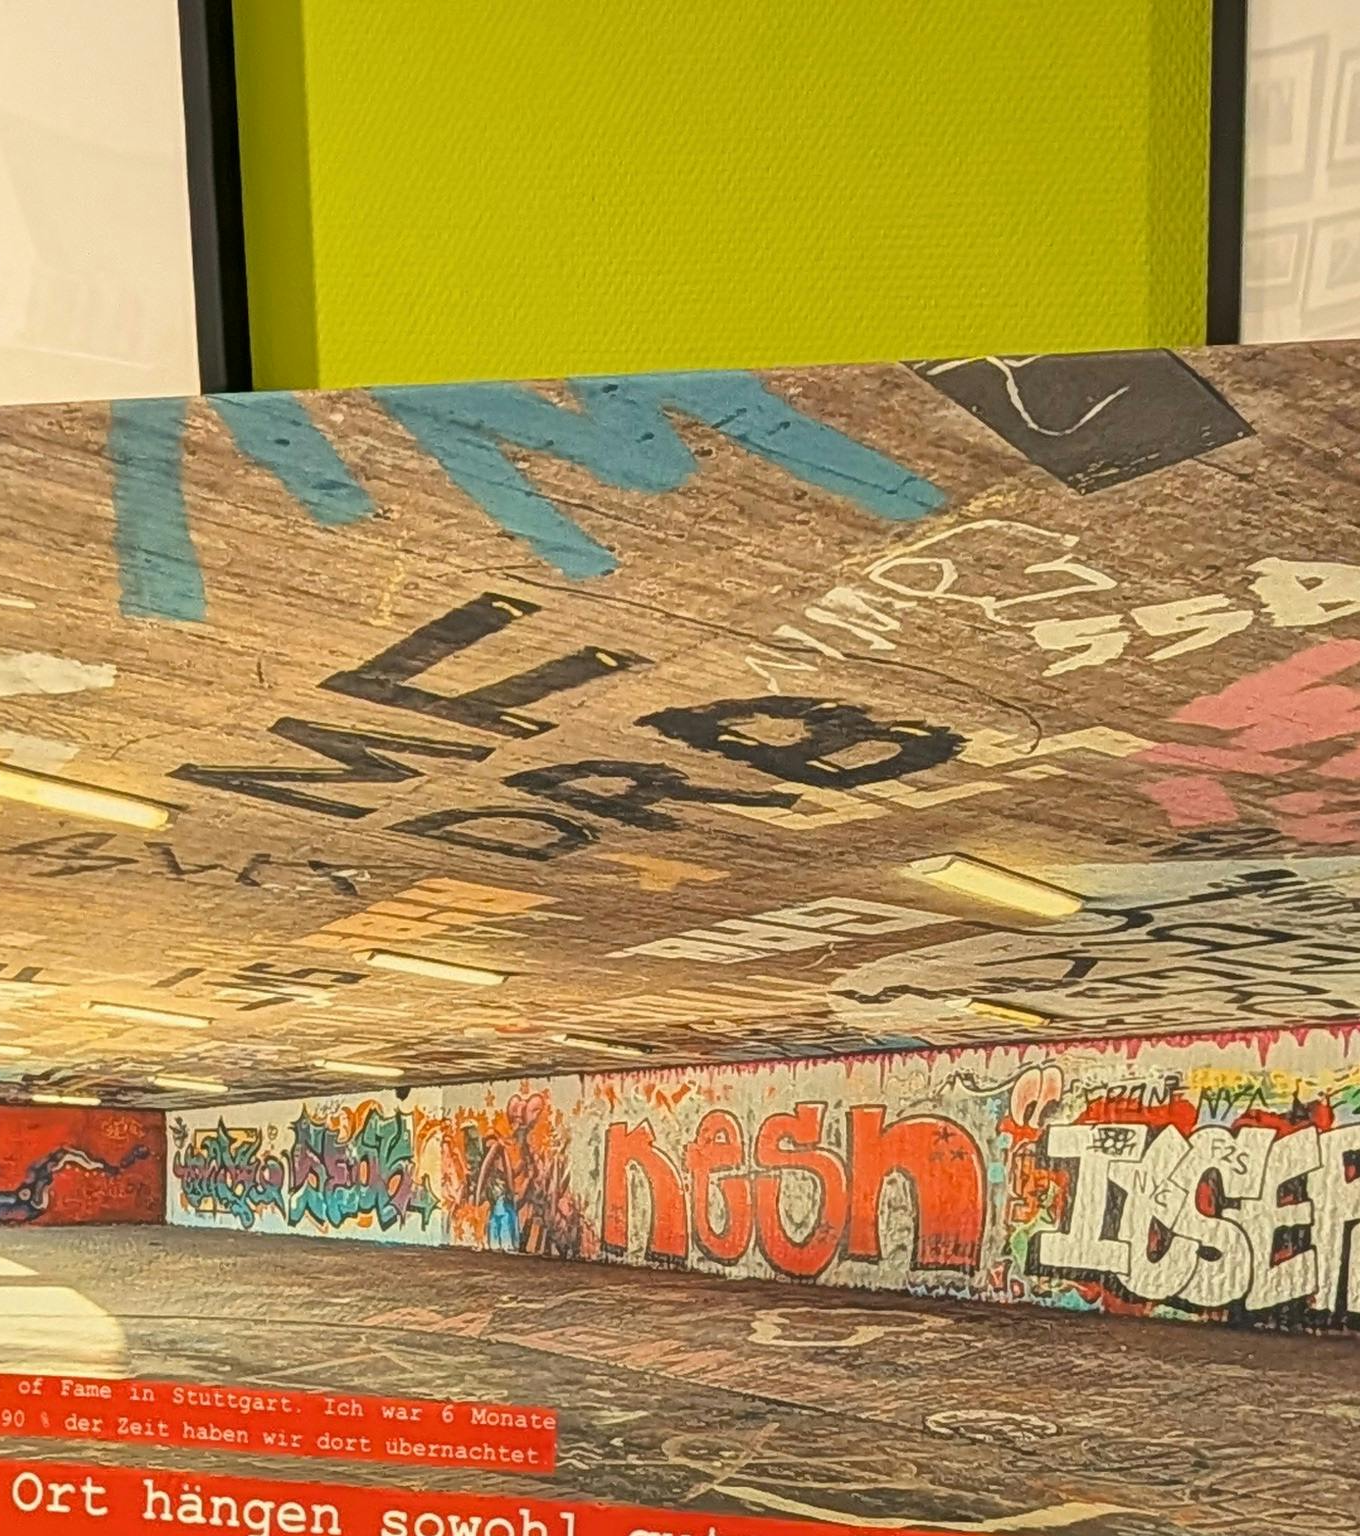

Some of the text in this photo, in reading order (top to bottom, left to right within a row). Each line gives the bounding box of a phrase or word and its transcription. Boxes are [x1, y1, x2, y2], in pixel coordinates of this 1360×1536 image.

[18, 1378, 44, 1395] of
[60, 1379, 113, 1399] Fame
[129, 1384, 155, 1402] in
[172, 1387, 302, 1415] Stuttgart.
[323, 1398, 365, 1417] Ich
[381, 1405, 423, 1422] war
[441, 1404, 455, 1424] 6
[470, 1407, 557, 1431] Monate
[1, 1409, 26, 1428] 90
[40, 1411, 51, 1429] %
[64, 1413, 104, 1433] der
[117, 1417, 169, 1437] Zeit
[183, 1421, 249, 1445] haben
[263, 1429, 303, 1449] wir
[316, 1432, 372, 1453] dort
[385, 1437, 549, 1465] übernachtet.
[12, 1471, 109, 1516] Ort
